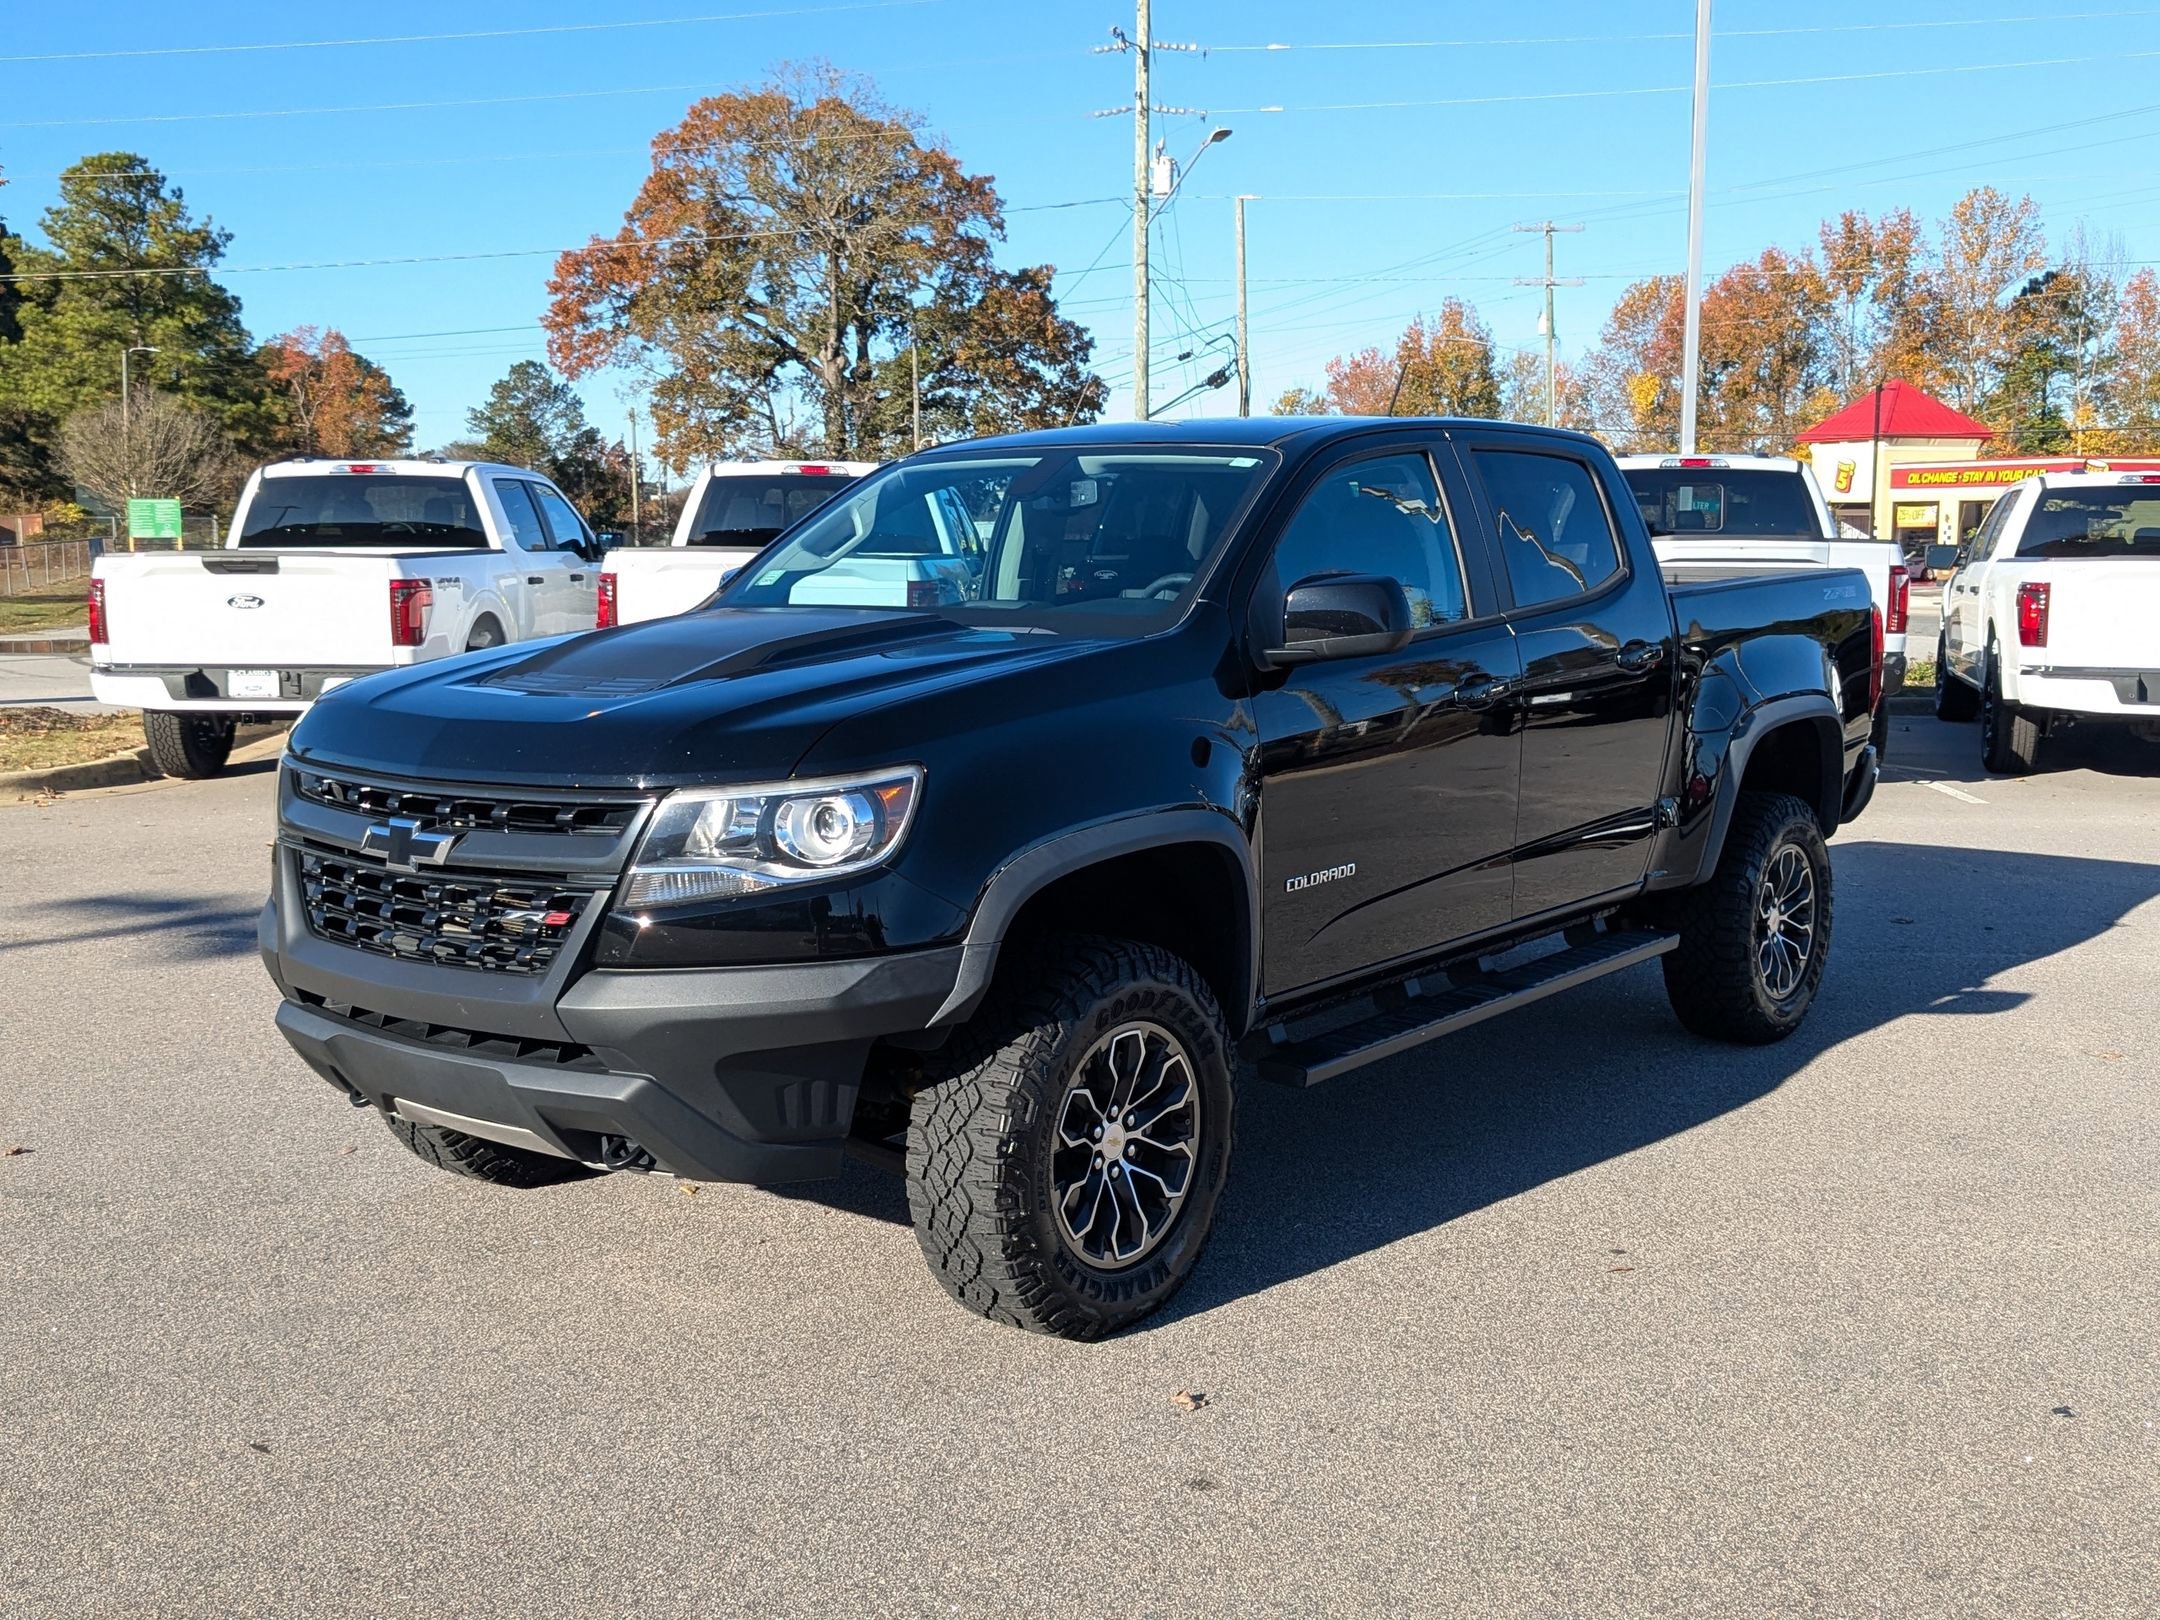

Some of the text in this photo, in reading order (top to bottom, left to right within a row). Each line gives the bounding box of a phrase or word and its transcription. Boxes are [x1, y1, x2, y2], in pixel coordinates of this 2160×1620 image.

[1837, 472, 1848, 490] 5
[1908, 472, 1921, 484] OIL
[1922, 471, 1959, 483] CHANGE
[1962, 471, 1984, 483] STAY
[1986, 470, 1997, 482] IN
[1999, 470, 2024, 482] YOUR
[231, 596, 260, 608] Ford
[1286, 863, 1356, 893] COLORADO
[1095, 990, 1216, 1062] GOODYEAR
[1054, 1246, 1172, 1303] WRANGLER
